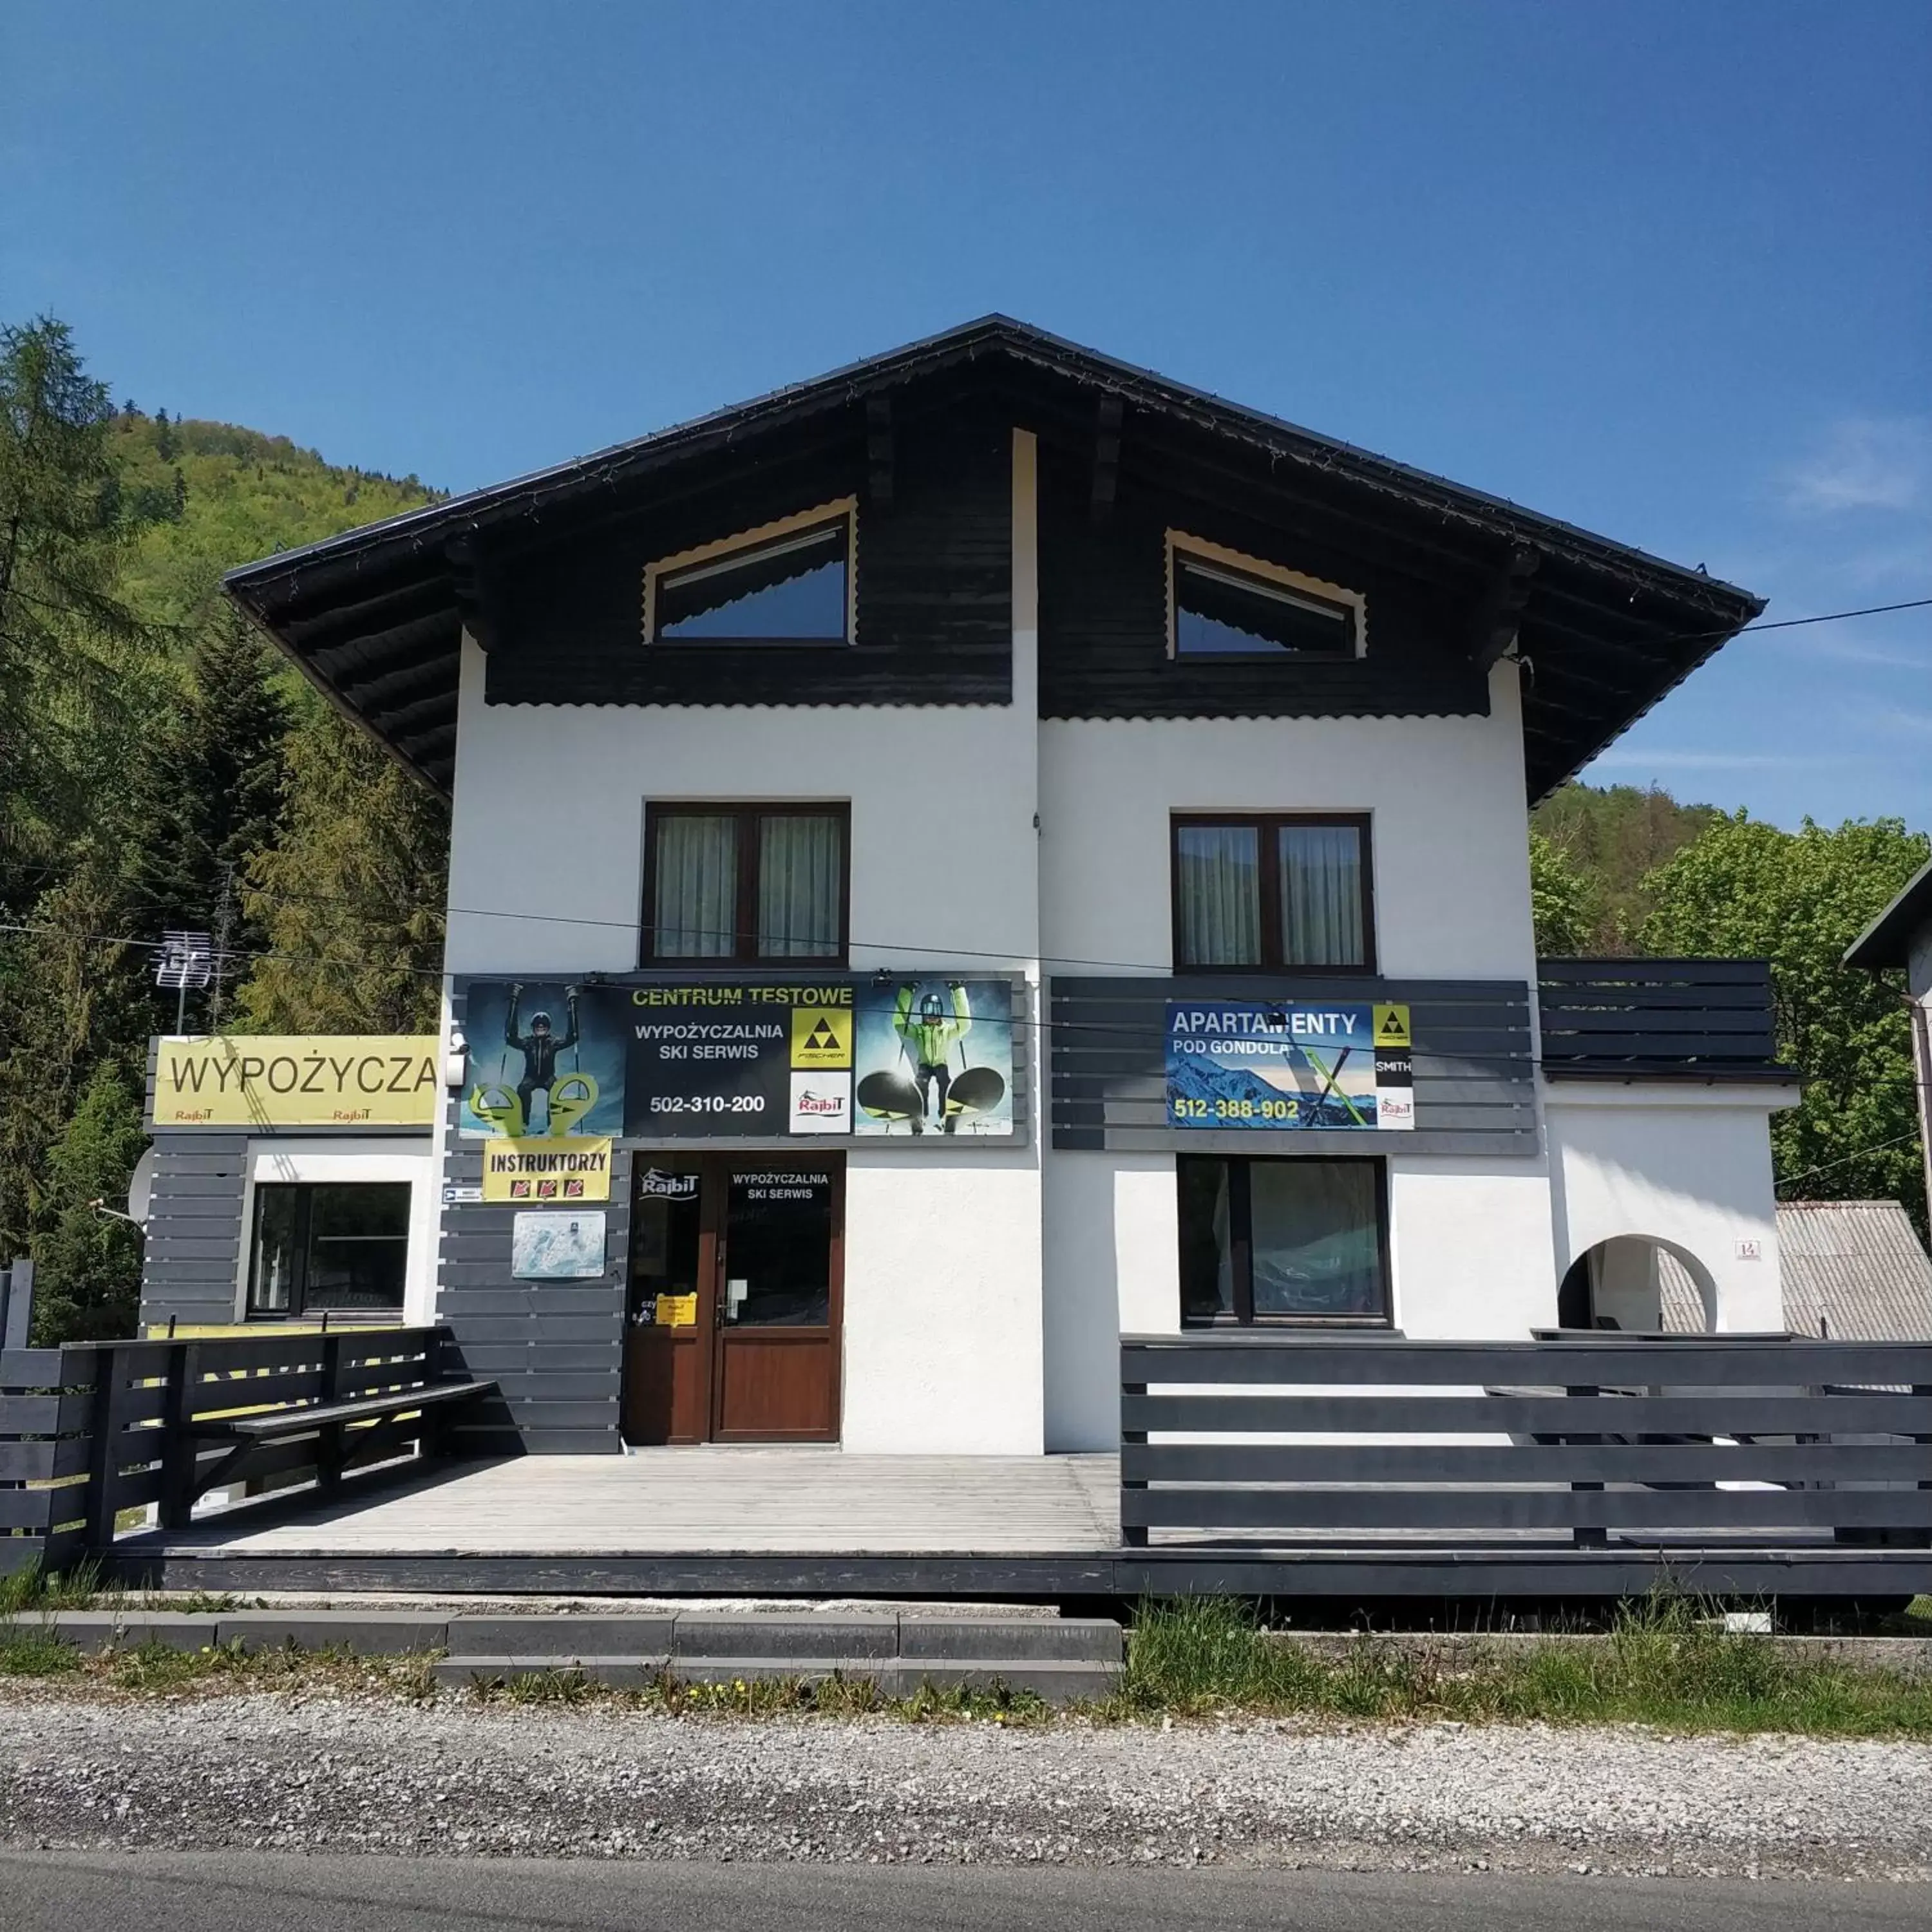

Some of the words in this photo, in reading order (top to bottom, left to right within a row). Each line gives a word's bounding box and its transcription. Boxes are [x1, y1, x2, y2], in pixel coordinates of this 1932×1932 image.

[633, 988, 741, 1005] CENTRUM
[748, 987, 853, 1004] TESTOWE
[635, 1022, 784, 1039] WYPOŻYCZALNIA
[659, 1046, 687, 1059] SKI
[692, 1045, 759, 1059] SERWIS
[1173, 1041, 1206, 1053] POD
[171, 1049, 437, 1093] WYPOŻYCZA
[1376, 1061, 1412, 1072] SMITH
[650, 1096, 765, 1113] 502-310-200
[1174, 1100, 1299, 1119] 512-388-902
[491, 1153, 607, 1172] INSTRUKTORZY
[732, 1172, 829, 1185] WYPOŻYCZALNIA
[748, 1189, 767, 1199] SKI
[769, 1189, 813, 1199] SERWIS
